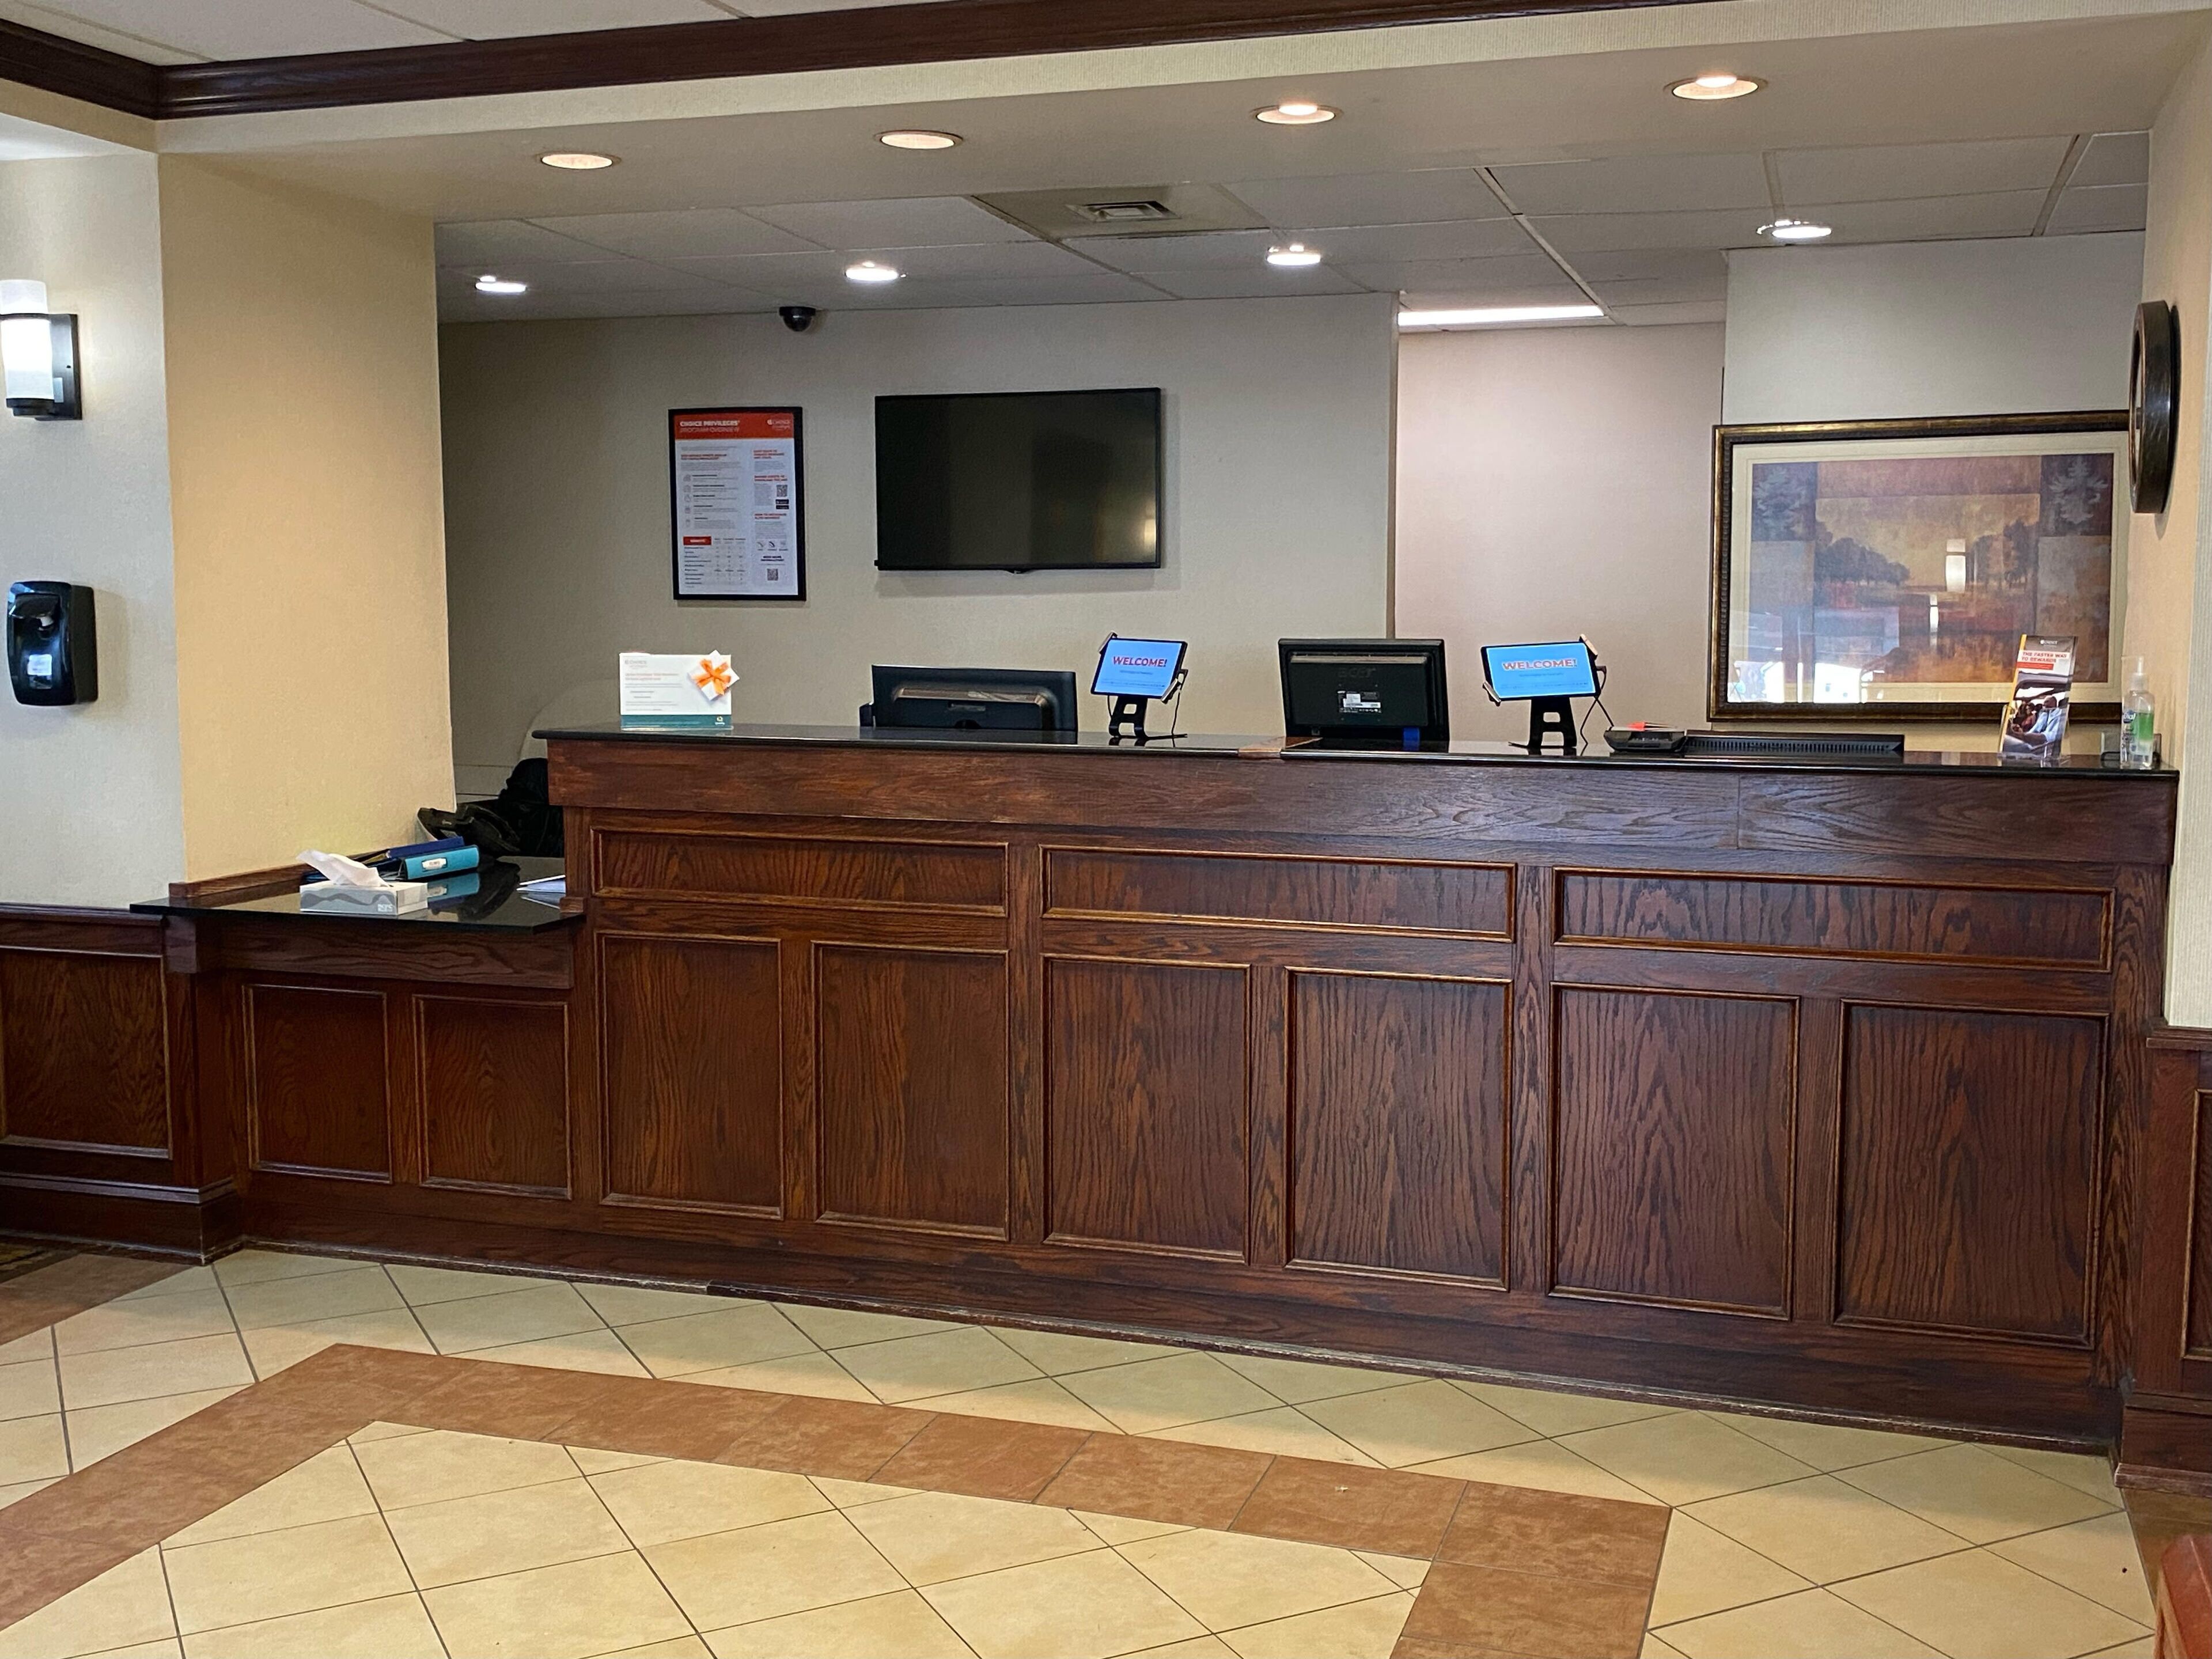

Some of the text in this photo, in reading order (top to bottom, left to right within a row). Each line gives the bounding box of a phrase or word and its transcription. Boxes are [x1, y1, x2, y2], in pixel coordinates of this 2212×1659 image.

[1112, 656, 1168, 668] WELCOME!
[1502, 658, 1578, 671] WELCOME!
[1337, 667, 1376, 678] acer
